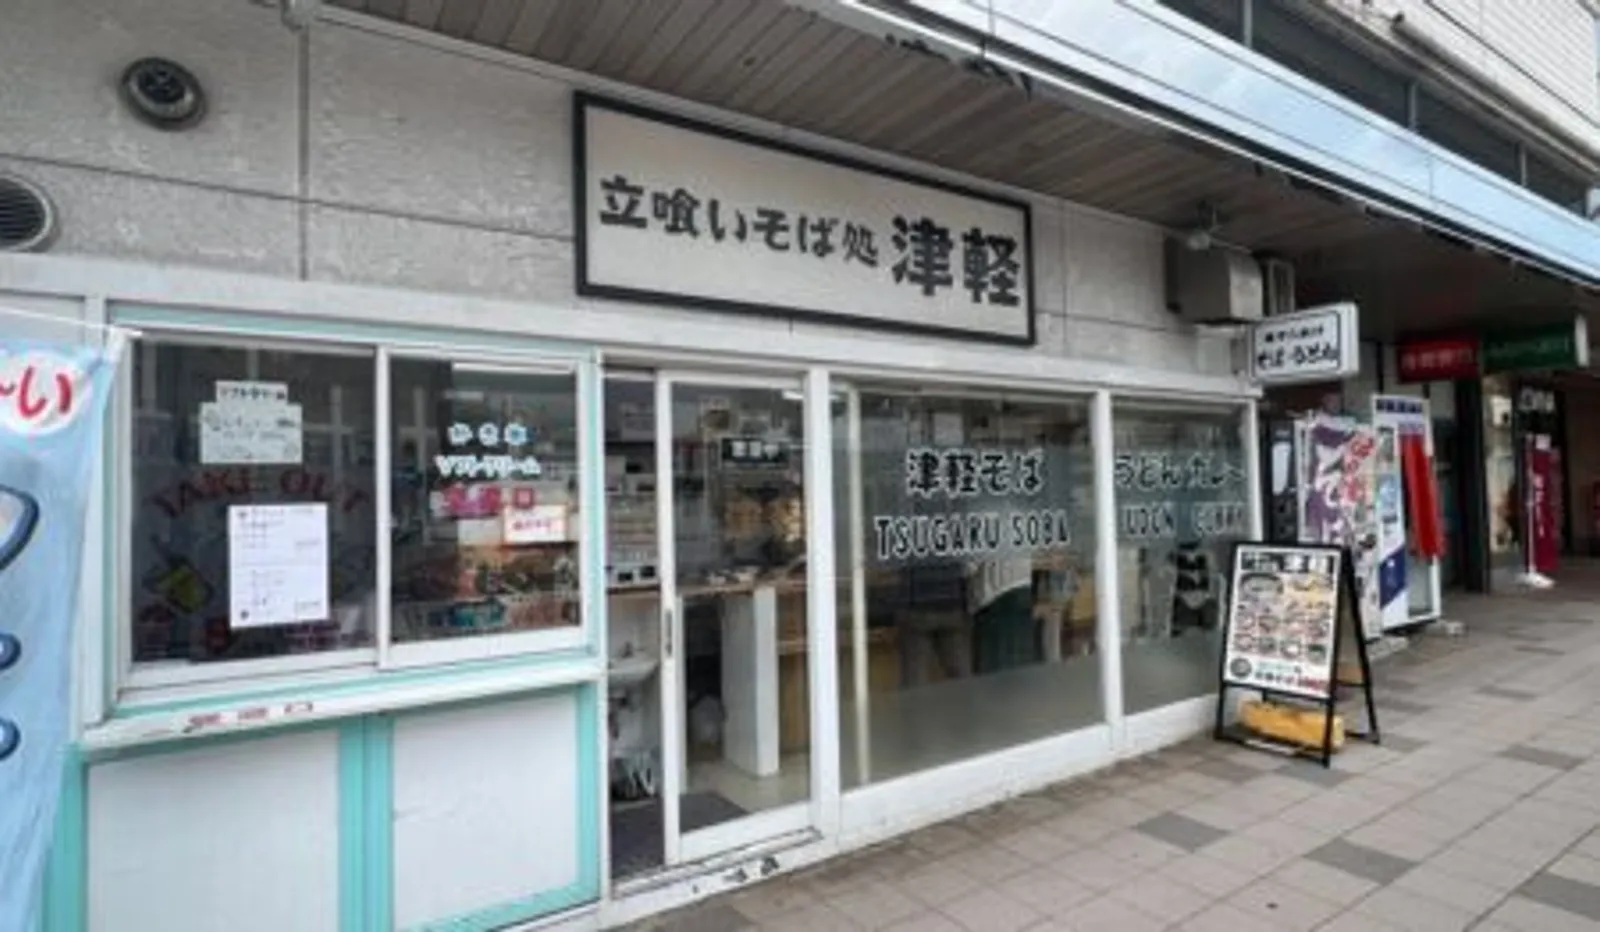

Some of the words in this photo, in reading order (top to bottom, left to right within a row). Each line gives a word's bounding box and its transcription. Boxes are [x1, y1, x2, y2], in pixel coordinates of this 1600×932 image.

[599, 174, 879, 268] 立喰いそば処
[890, 215, 1020, 307] 津軽
[904, 447, 1045, 499] 津軽そば
[873, 512, 1001, 559] TSUGARU
[1010, 509, 1071, 551] SOBA
